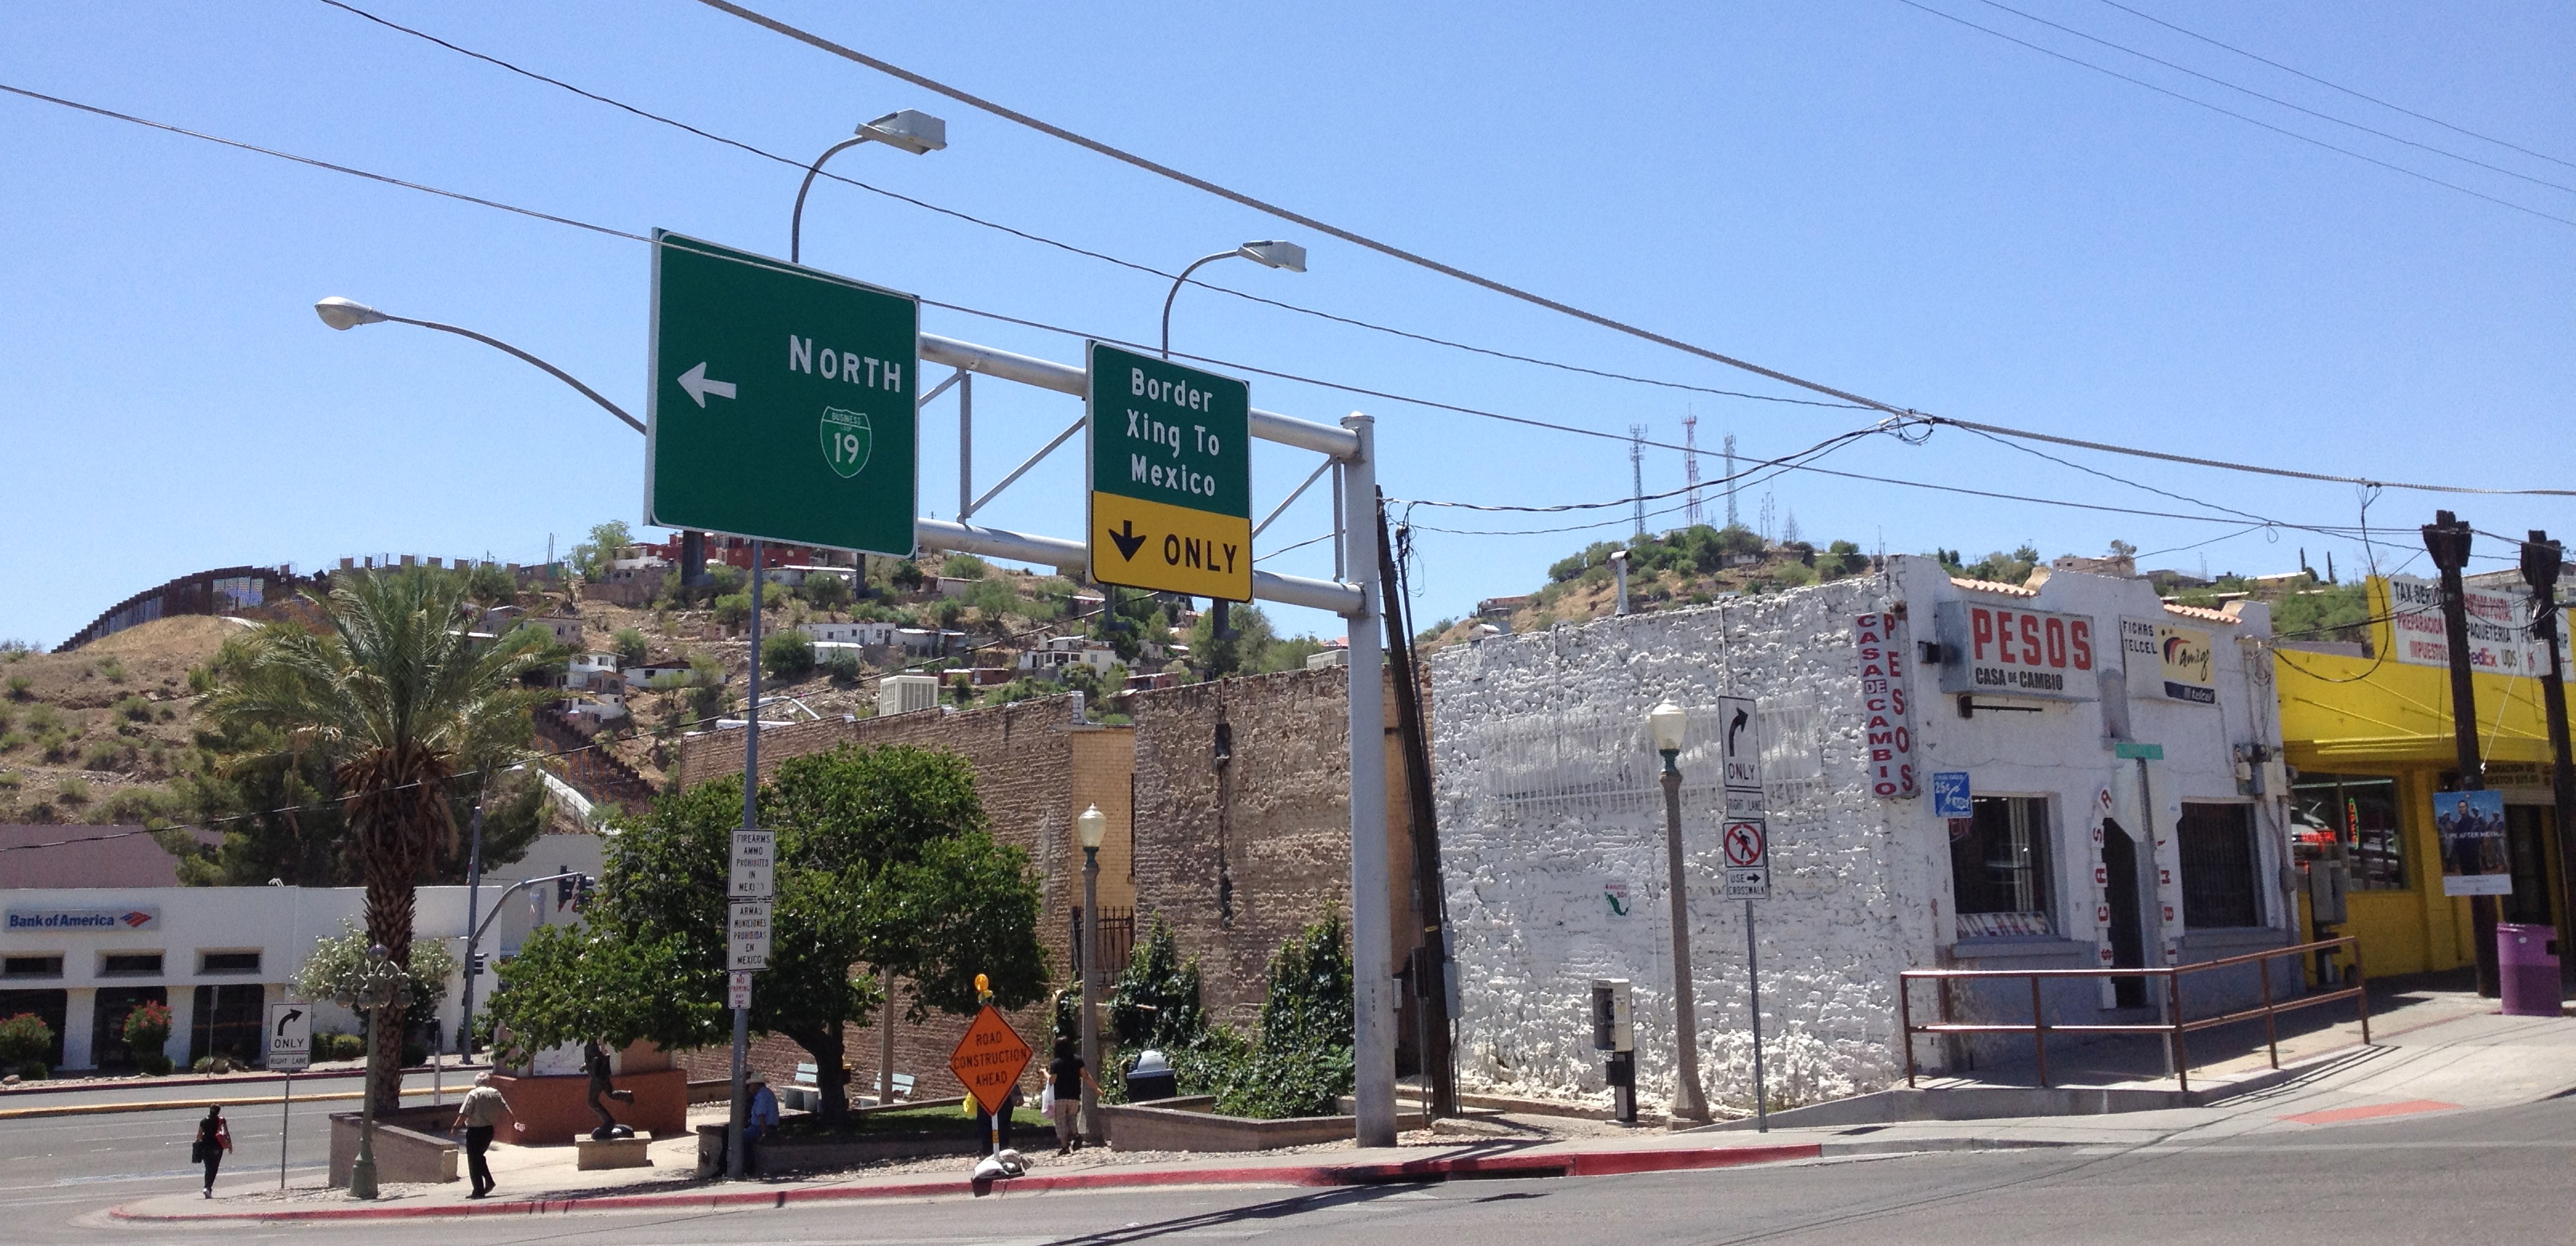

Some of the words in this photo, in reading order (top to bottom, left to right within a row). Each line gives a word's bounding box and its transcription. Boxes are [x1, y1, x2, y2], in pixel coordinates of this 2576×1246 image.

[789, 334, 902, 393] NORTH
[1131, 366, 1214, 413] Border
[831, 412, 862, 425] BUSINESS
[1126, 408, 1181, 458] Xing
[1193, 424, 1220, 456] To
[834, 432, 859, 464] 19
[1131, 453, 1216, 497] Mexico
[1163, 533, 1238, 575] ONLY
[2393, 581, 2412, 603] TAX
[2122, 619, 2155, 637] FICHAS
[1857, 614, 1884, 678] CASA
[1971, 607, 2092, 671] PESOS
[2124, 638, 2159, 655] TELCEL
[2470, 647, 2498, 668] edEx
[1864, 679, 1888, 695] DE
[1974, 667, 2007, 687] CASA
[2008, 671, 2019, 683] DE
[2019, 670, 2064, 691] CAMBIO
[1883, 613, 1914, 792] PESOS
[1867, 698, 1898, 796] CAMBIO
[1728, 762, 1756, 780] ONLY
[1748, 799, 1763, 812] LANE
[736, 833, 771, 844] FIREARMS
[743, 846, 764, 856] AMMO
[736, 858, 769, 868] PROHIBITED
[748, 870, 756, 880] IN
[1730, 873, 1745, 883] USE
[1729, 885, 1765, 896] CROSSWALK
[739, 906, 763, 916] ARMAS
[9, 914, 43, 927] Bank
[43, 913, 59, 927] of
[59, 913, 115, 927] America
[745, 943, 755, 952] EN
[737, 954, 762, 966] MEXICO
[731, 985, 751, 993] PARKING
[274, 1038, 304, 1049] ONLY
[976, 1031, 1002, 1046] ROAD
[953, 1049, 1028, 1070] CONSTRUCTION
[976, 1071, 1008, 1087] AHEAD
